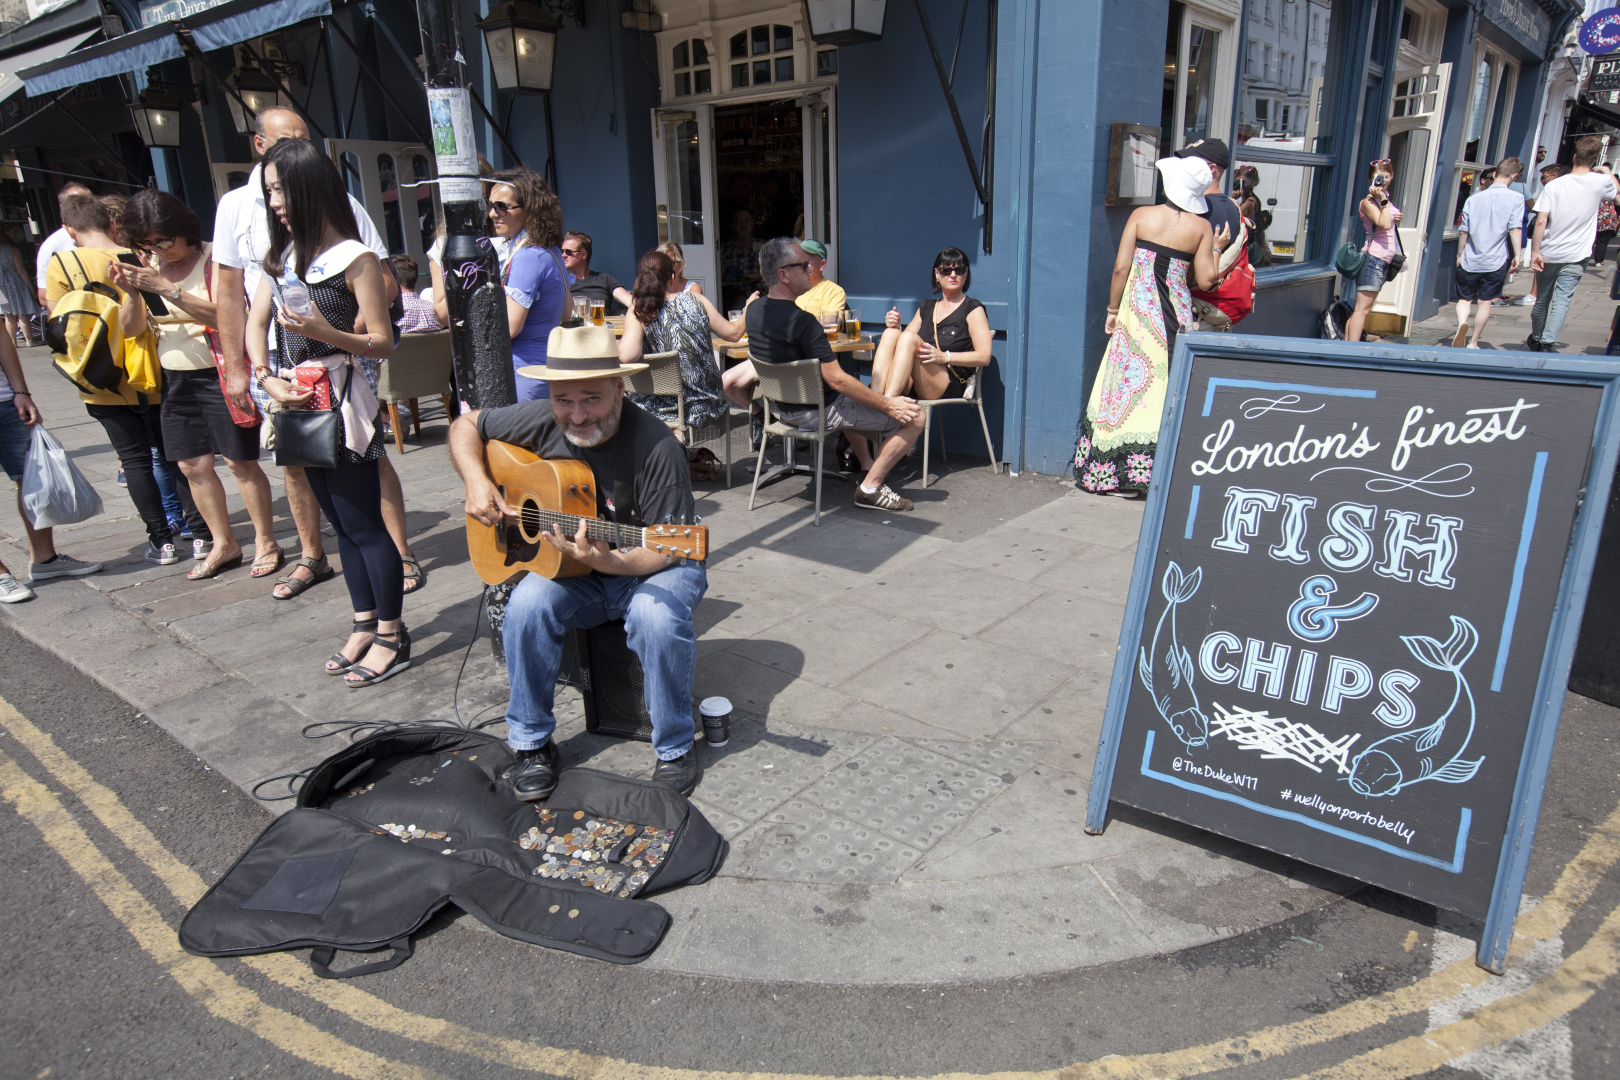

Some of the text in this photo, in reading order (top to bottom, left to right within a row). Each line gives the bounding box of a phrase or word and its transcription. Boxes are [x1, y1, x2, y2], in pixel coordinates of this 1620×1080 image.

[152, 8, 176, 23] THE
[178, 0, 207, 18] DUKE
[1191, 398, 1541, 476] London's finest
[1211, 486, 1464, 590] FISH
[1286, 574, 1380, 643] &
[1199, 631, 1421, 728] CHIPS
[1172, 756, 1259, 791] @TheDukeW11
